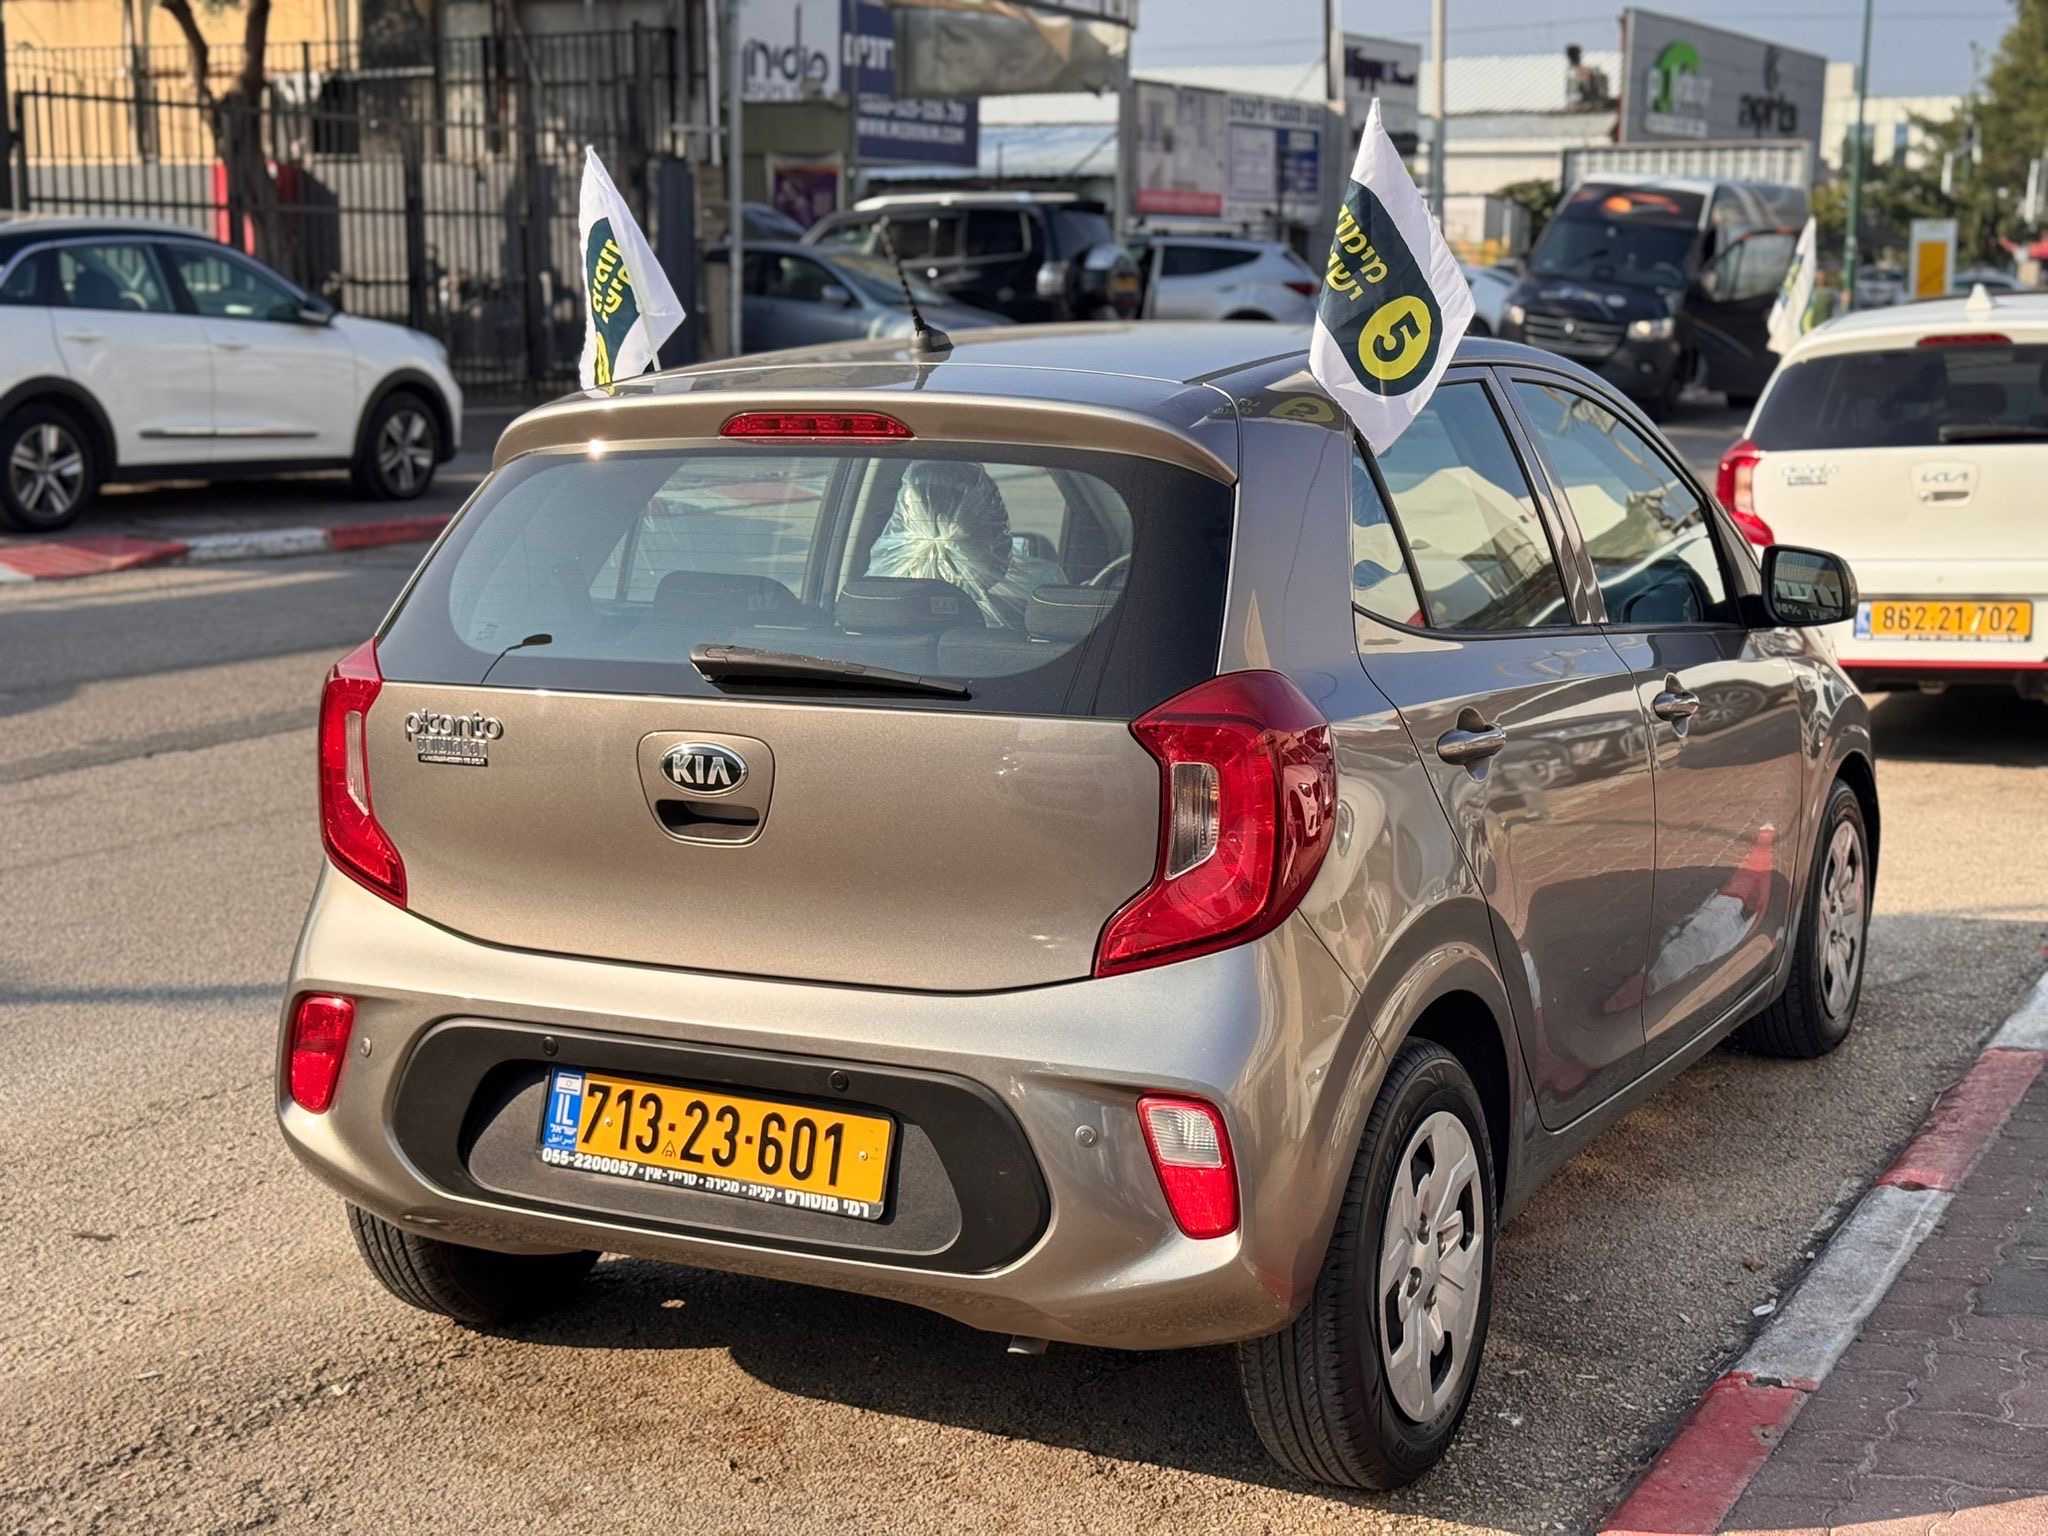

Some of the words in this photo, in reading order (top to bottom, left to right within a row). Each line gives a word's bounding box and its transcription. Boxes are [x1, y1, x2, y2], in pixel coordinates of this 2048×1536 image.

[1372, 309, 1421, 362] 5
[405, 708, 504, 742] picanto
[671, 753, 732, 786] KIA
[555, 1093, 574, 1126] IL
[549, 1122, 577, 1136] ישראל
[541, 1147, 638, 1177] 055-2200057
[644, 1166, 698, 1186] טרייד-אין
[705, 1176, 740, 1194] מכירה
[748, 1184, 775, 1202] קניה
[784, 1188, 839, 1213] מוטורס
[842, 1198, 870, 1218] רמי
